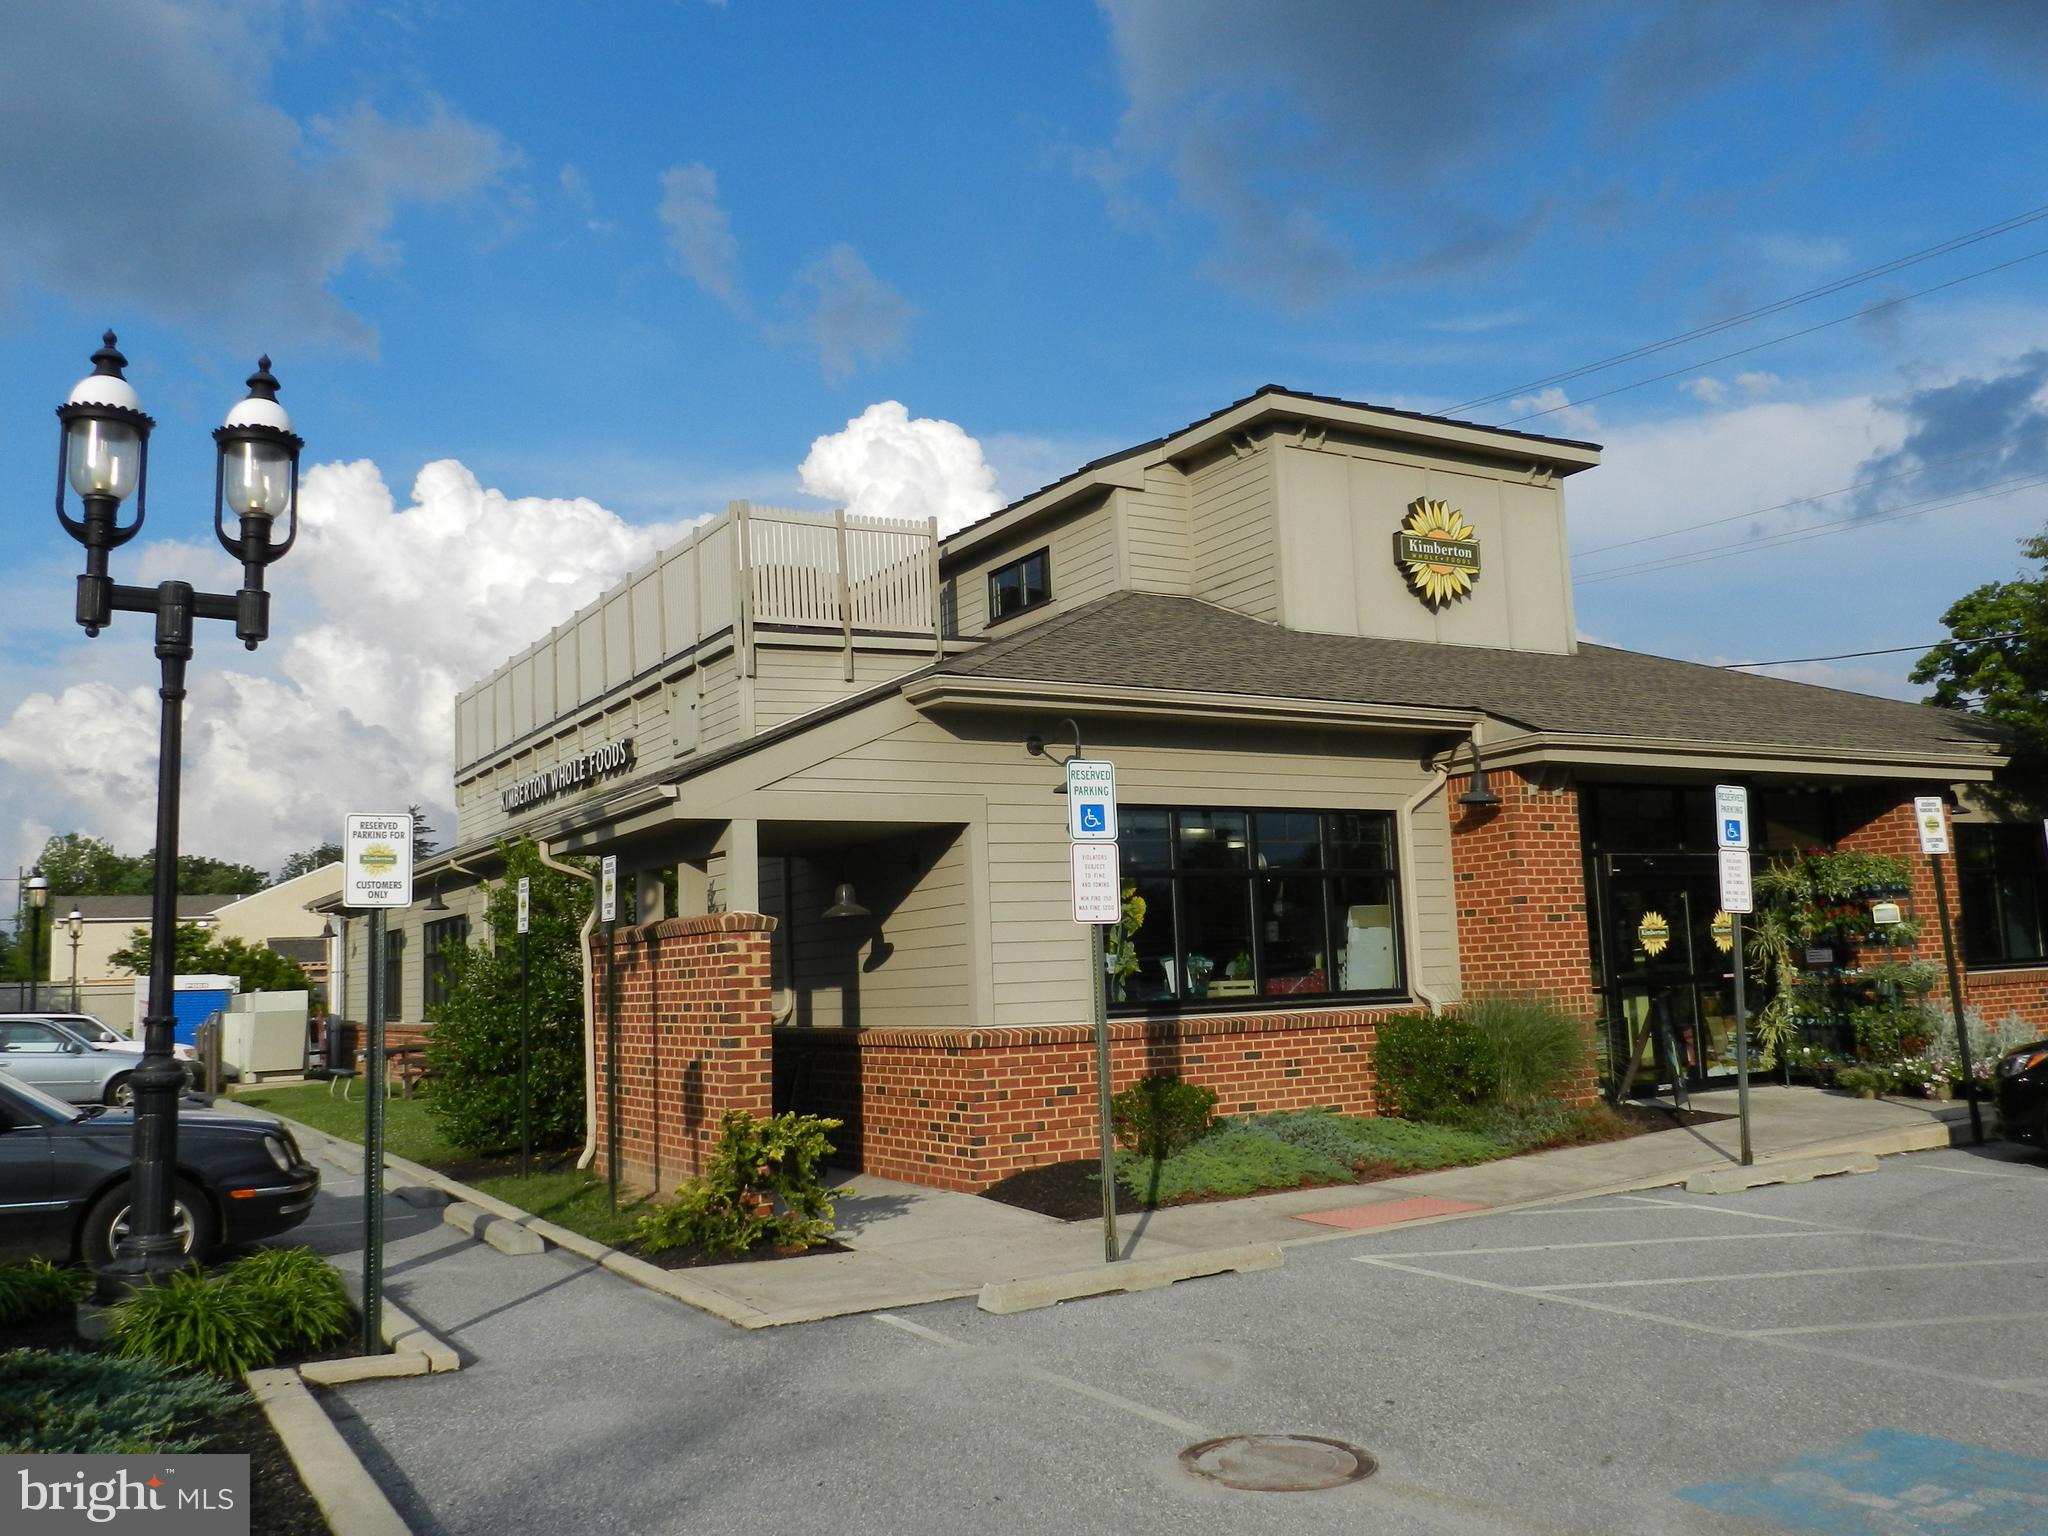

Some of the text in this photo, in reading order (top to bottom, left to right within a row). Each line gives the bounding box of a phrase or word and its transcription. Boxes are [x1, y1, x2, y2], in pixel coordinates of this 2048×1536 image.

[1409, 539, 1472, 559] Kimberton
[501, 738, 627, 812] KIMBERTON WHOLE FOODS
[1070, 769, 1111, 781] RESERVED
[1074, 785, 1109, 796] PARKING
[360, 821, 398, 830] RESERVED
[352, 830, 405, 839] PARKING FOR
[356, 880, 402, 889] CUSTOMERS
[368, 890, 388, 899] ONLY
